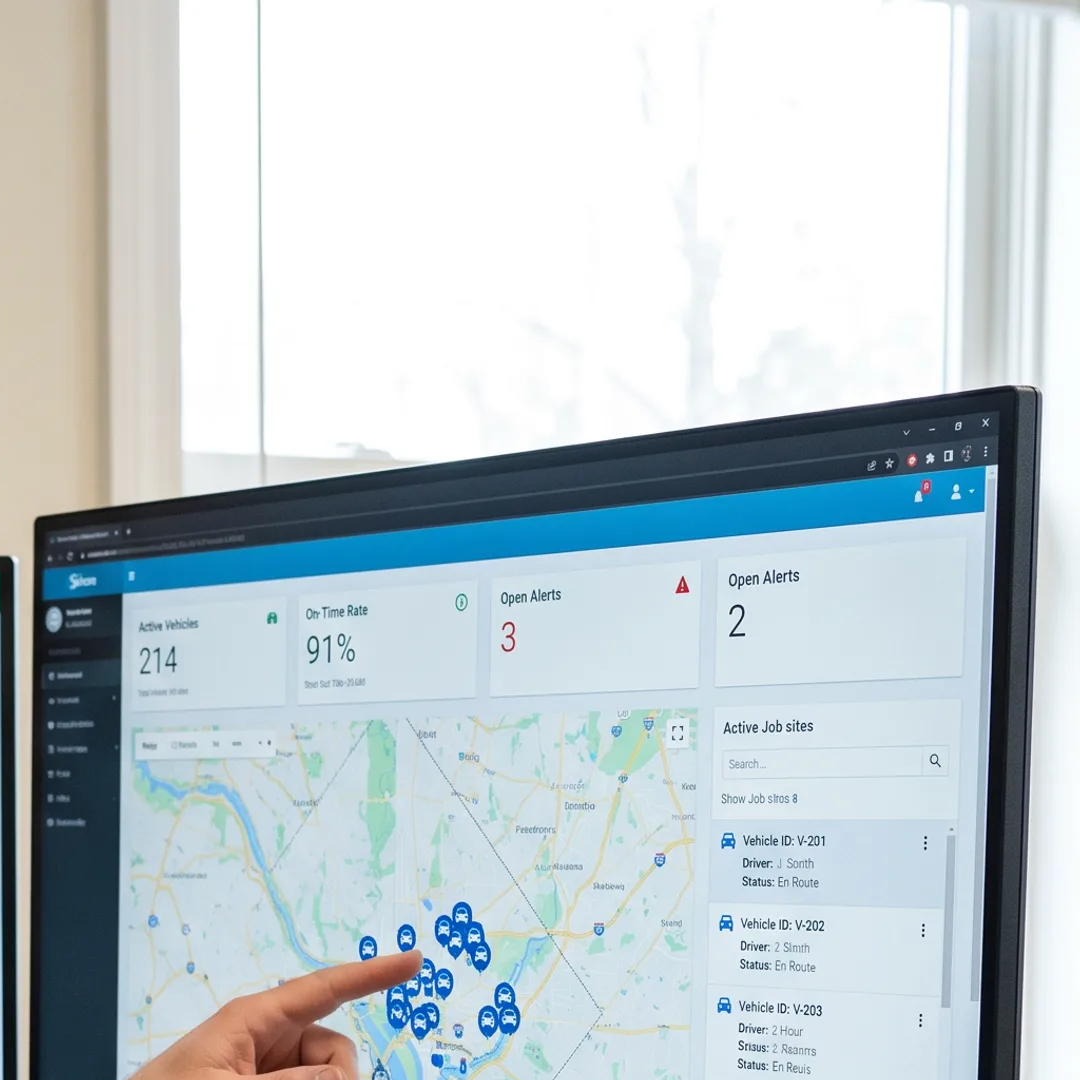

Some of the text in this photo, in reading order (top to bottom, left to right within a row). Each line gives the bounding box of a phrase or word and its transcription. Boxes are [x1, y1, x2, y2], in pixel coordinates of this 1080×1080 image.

[728, 568, 800, 590] Open Alerts
[501, 589, 561, 607] Open Alerts
[347, 605, 368, 617] Rate
[138, 618, 199, 633] Active Vehicles
[728, 604, 746, 637] 2
[501, 621, 516, 652] 3
[306, 633, 356, 664] 91%
[139, 646, 177, 675] 214
[723, 718, 814, 735] Active Job sites
[728, 758, 767, 771] Search...
[721, 793, 746, 805] Show
[748, 793, 765, 805] Job
[743, 835, 826, 847] Vehicle ID: V-201
[742, 857, 773, 869] Driver:
[742, 876, 820, 889] Status: En Route
[741, 918, 825, 932] Vehicle ID: V-202
[740, 941, 771, 953] Driver:
[774, 942, 780, 953] 2
[739, 959, 816, 973] Status: En Route
[739, 1000, 823, 1017] Vehicle ID: V-203
[738, 1023, 804, 1037] Driver: 2 Hour
[737, 1058, 769, 1071] Status:
[772, 1061, 784, 1072] En
